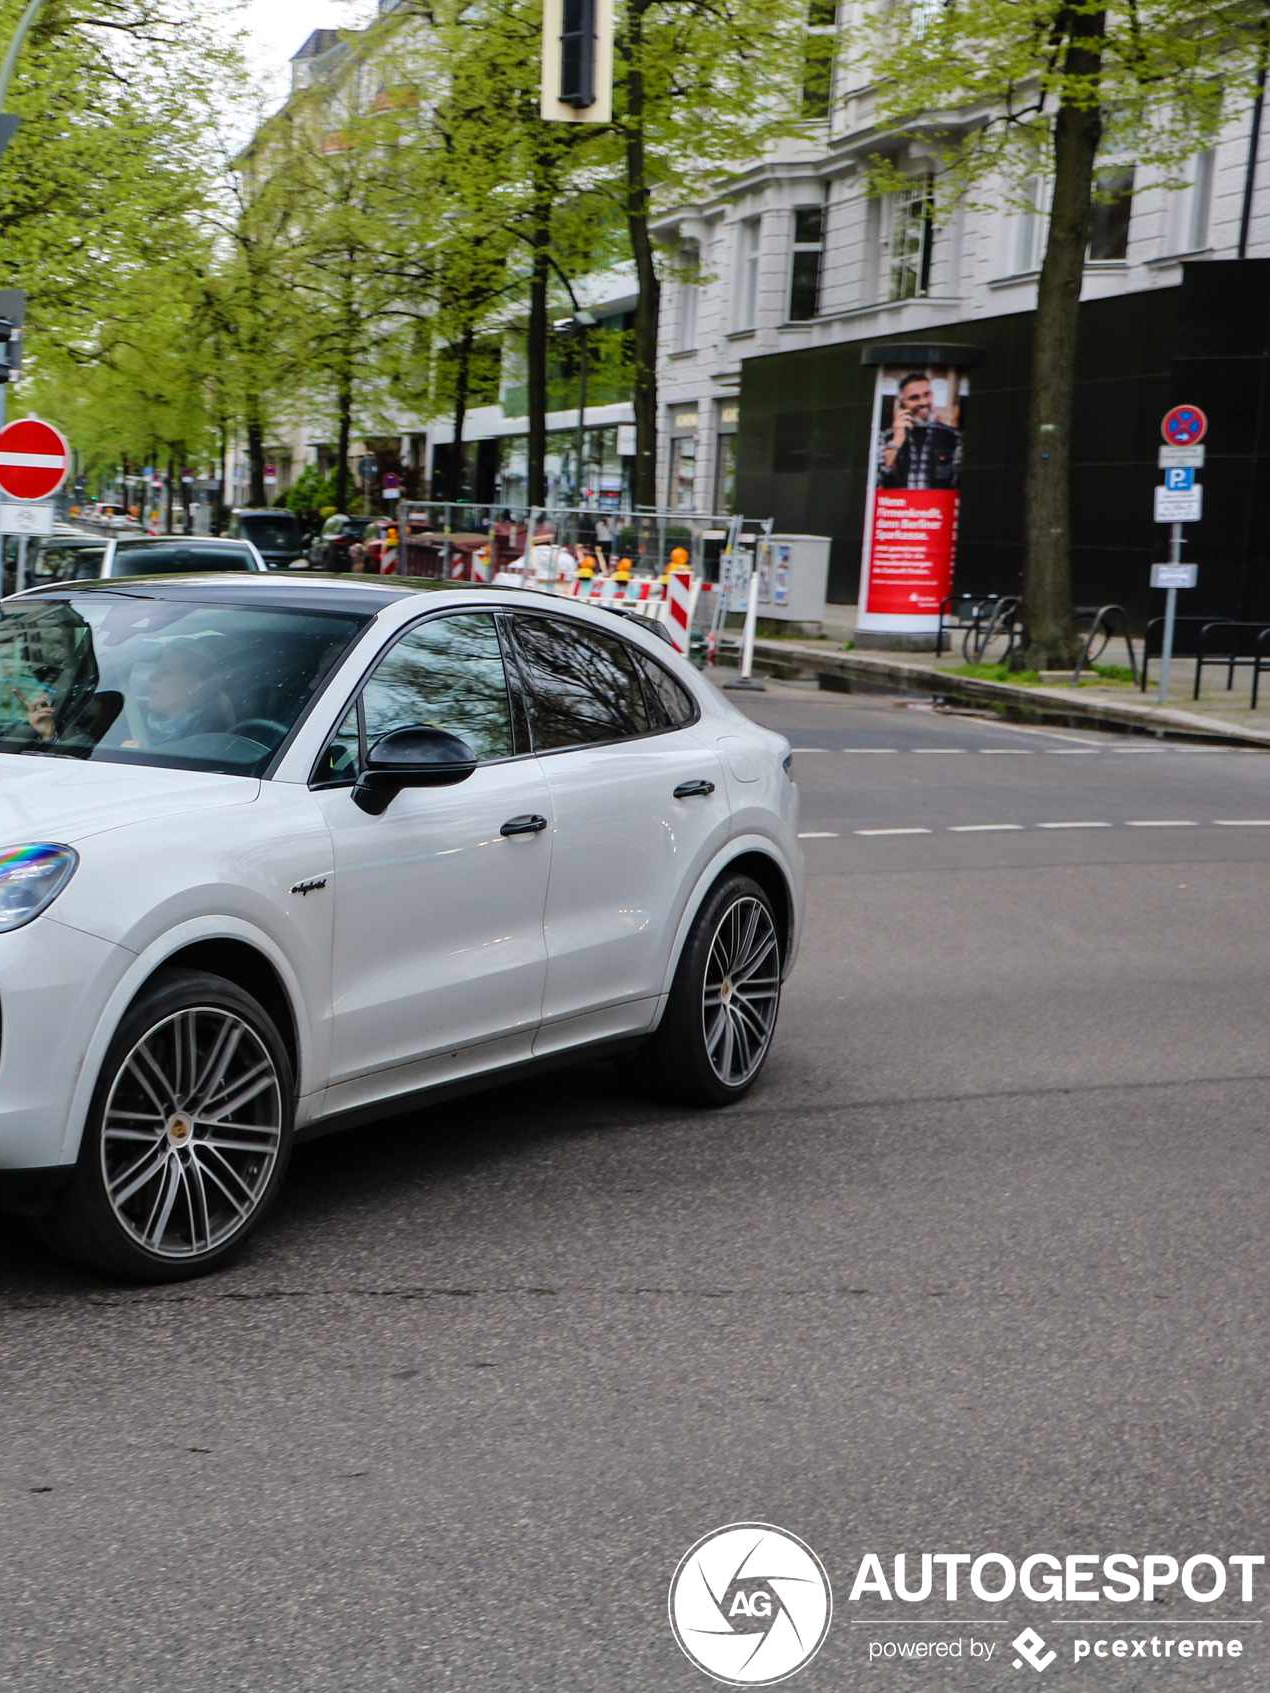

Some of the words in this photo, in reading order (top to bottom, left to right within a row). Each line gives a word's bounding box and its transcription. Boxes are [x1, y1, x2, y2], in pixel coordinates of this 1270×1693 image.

[877, 496, 907, 507] Wenn
[875, 518, 899, 529] dann
[900, 518, 942, 530] Berliner
